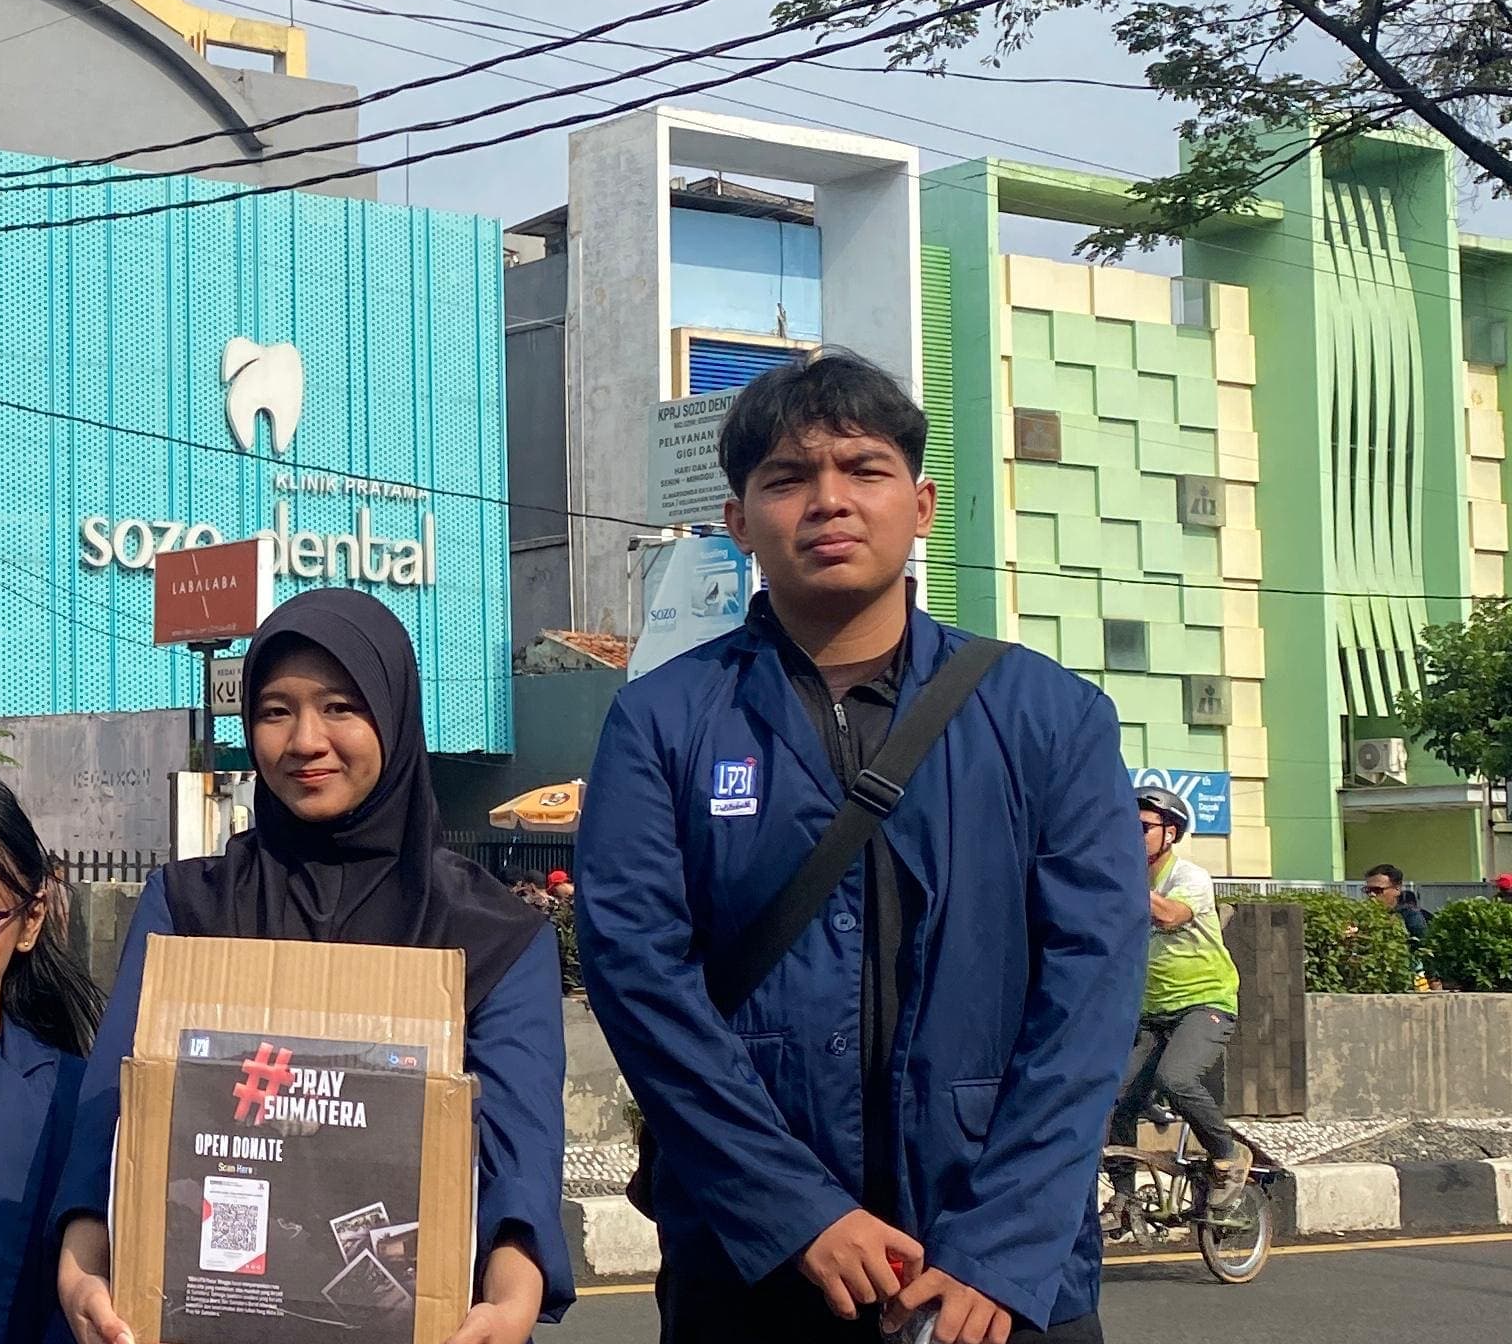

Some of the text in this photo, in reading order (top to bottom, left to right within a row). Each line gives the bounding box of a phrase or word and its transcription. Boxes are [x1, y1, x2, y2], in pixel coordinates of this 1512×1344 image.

[658, 405, 681, 423] KPRJ
[682, 400, 706, 417] SOZO
[659, 429, 714, 449] PELAYANAN
[676, 448, 697, 460] GIGI
[274, 473, 430, 500] KLINIK PRATAMA
[255, 501, 436, 586] dental
[650, 607, 677, 622] SOZO
[263, 1095, 368, 1129] SUMATERA
[194, 1132, 285, 1163] OPEN DONATE
[218, 1161, 236, 1173] Scan
